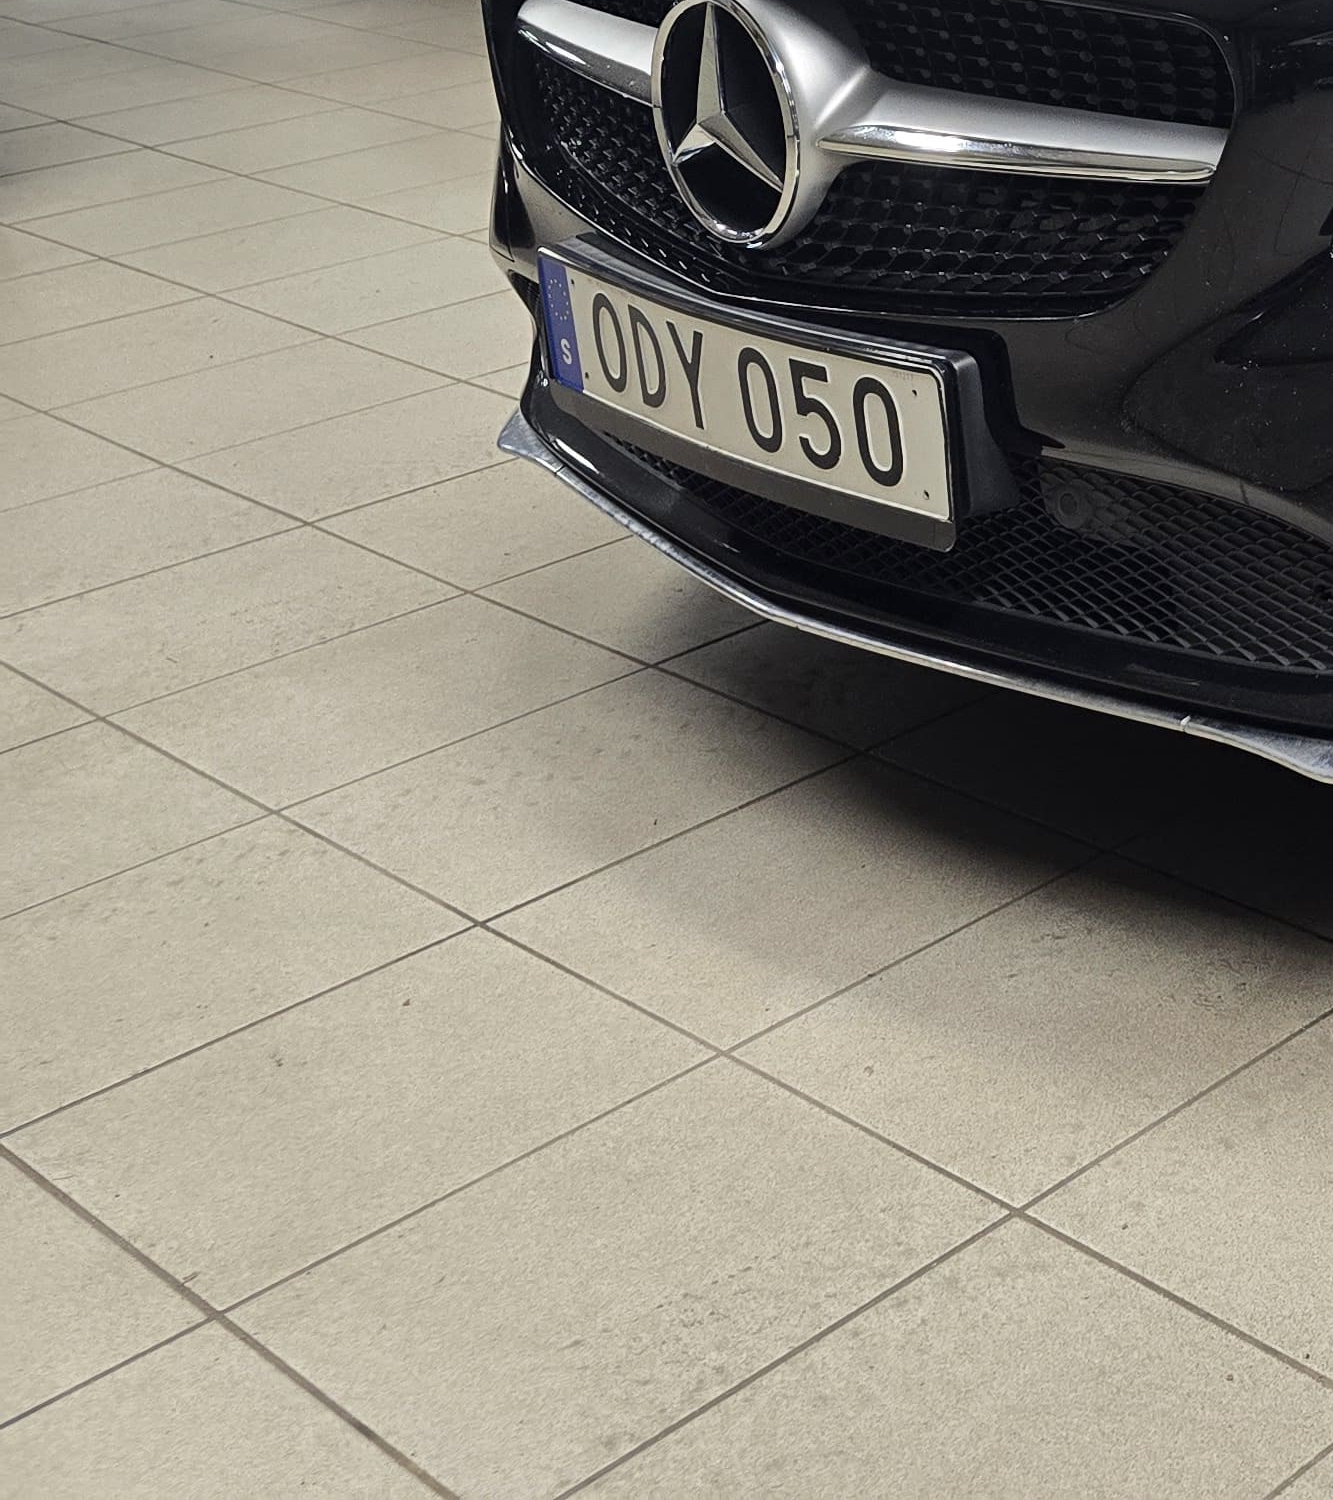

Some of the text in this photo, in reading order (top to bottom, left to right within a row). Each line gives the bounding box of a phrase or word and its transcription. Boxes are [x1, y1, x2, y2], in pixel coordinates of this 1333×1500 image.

[559, 338, 573, 365] S
[591, 292, 905, 488] ODY 050
